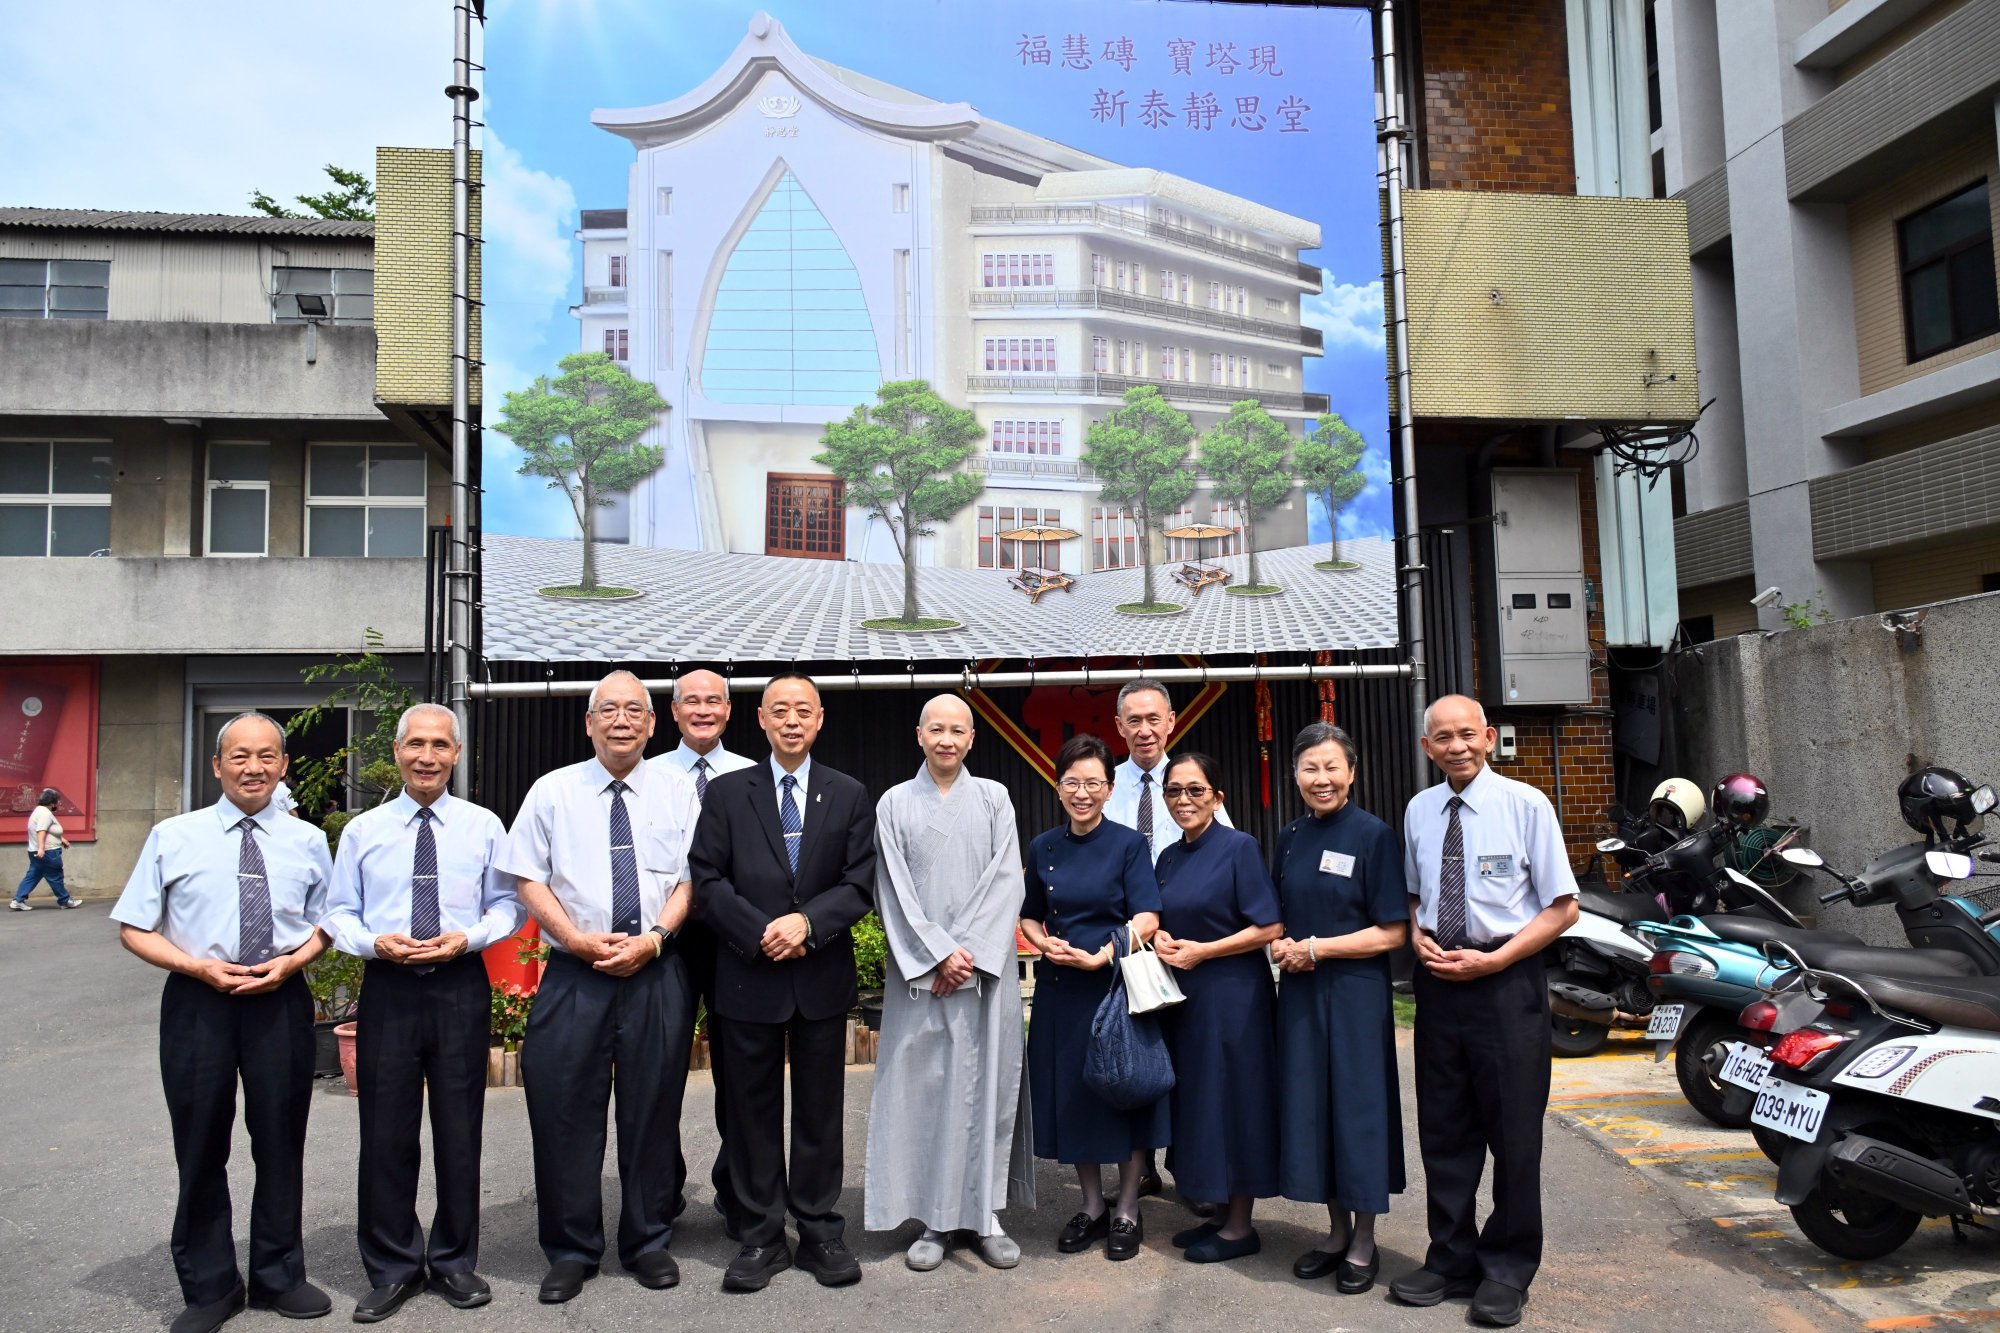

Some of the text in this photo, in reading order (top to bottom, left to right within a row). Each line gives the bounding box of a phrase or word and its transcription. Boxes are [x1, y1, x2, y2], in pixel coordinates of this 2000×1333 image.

[1015, 32, 1285, 77] 福慧磚 寶塔現
[1089, 87, 1312, 134] 新泰靜思堂
